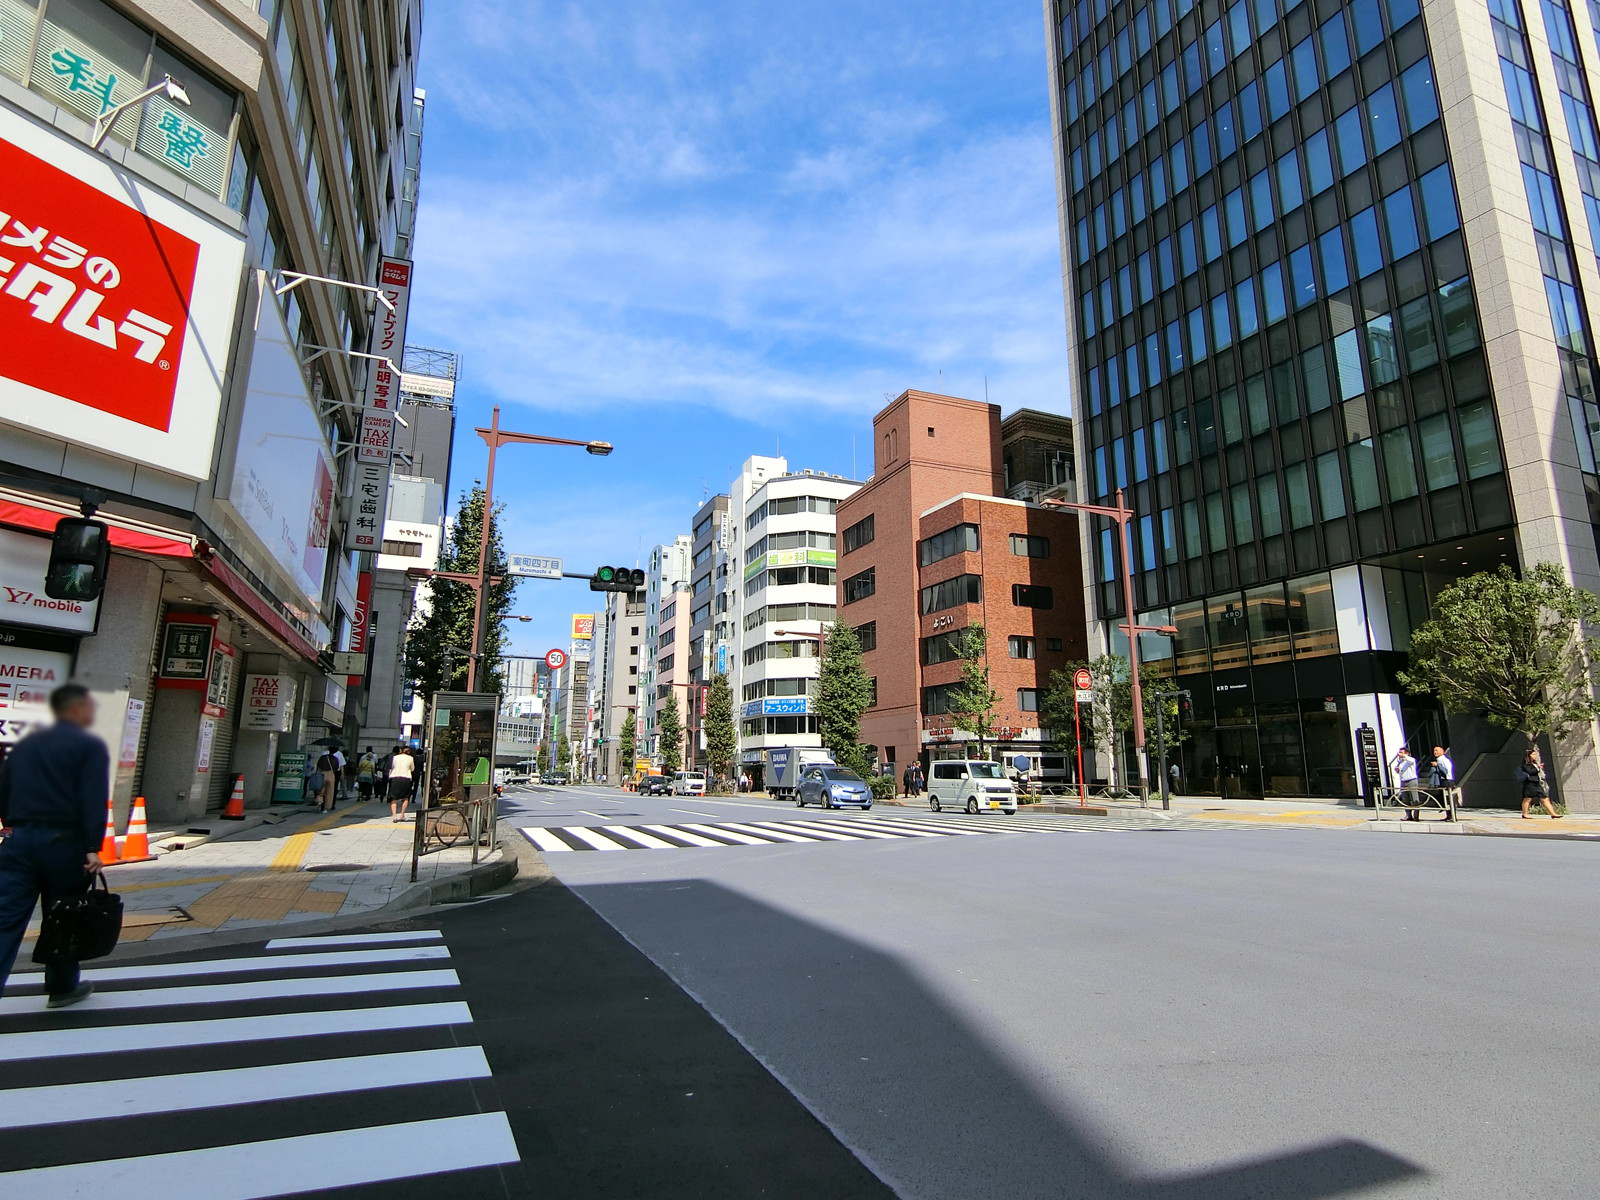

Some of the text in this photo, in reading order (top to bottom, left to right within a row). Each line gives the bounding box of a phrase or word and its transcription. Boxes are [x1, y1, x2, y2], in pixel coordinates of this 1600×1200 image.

[0, 210, 121, 289] メラの
[364, 420, 391, 428] CAMERA
[364, 428, 390, 440] TAX
[362, 437, 389, 448] FREE
[513, 557, 559, 569] 室町四丁目
[933, 615, 954, 628] よこい
[550, 654, 562, 663] 50
[254, 678, 279, 687] TAX
[252, 687, 278, 696] FREE
[765, 704, 805, 713] アースウィンド
